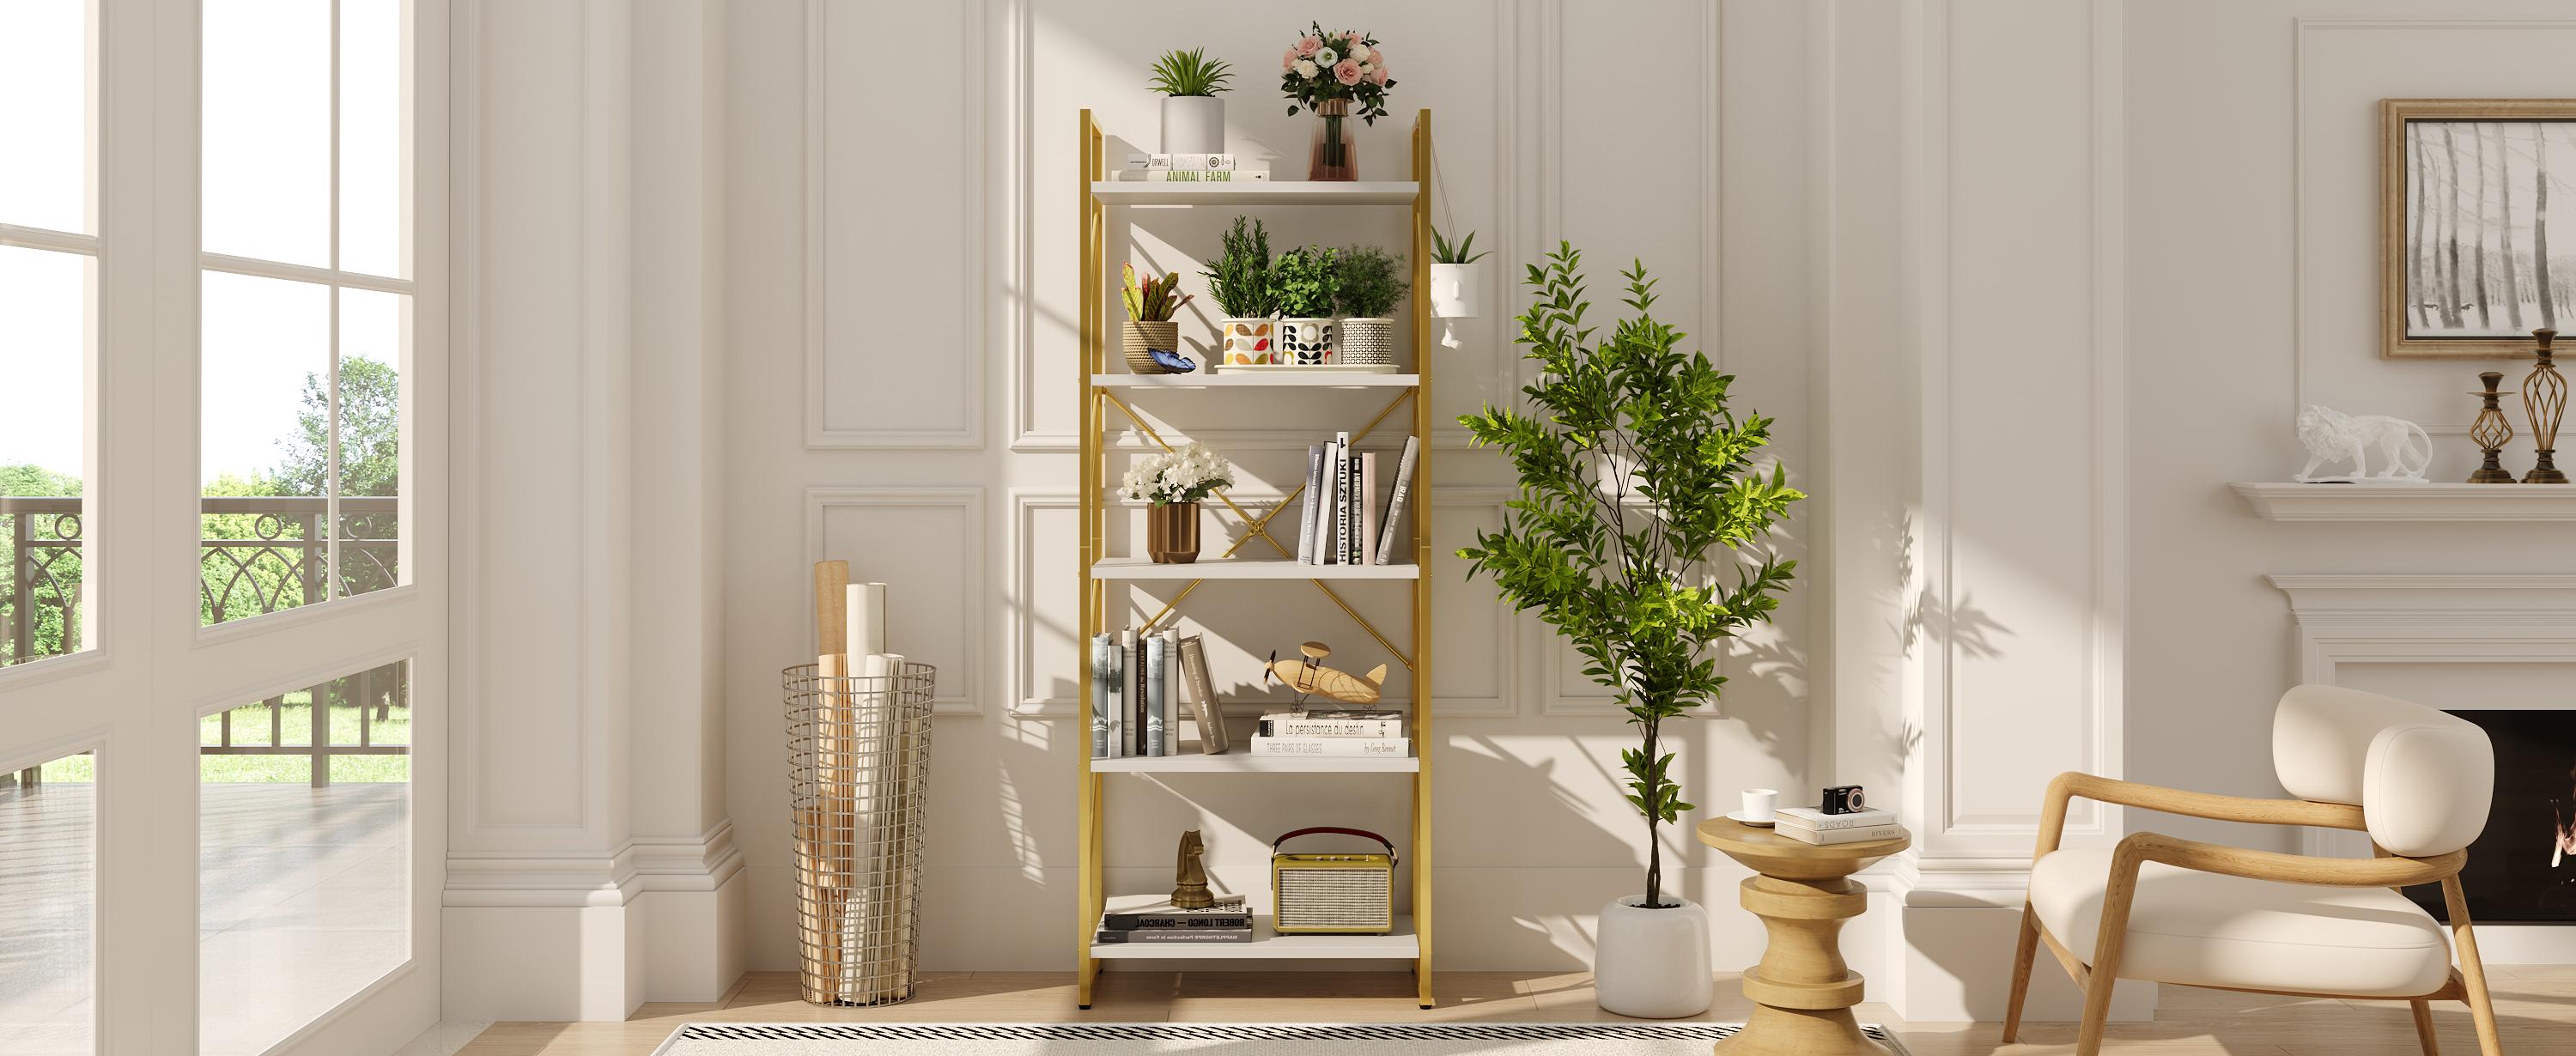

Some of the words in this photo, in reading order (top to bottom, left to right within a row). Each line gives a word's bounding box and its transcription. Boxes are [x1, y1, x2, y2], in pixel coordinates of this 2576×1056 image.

[1151, 157, 1169, 167] ORWELL
[1166, 171, 1200, 182] ANIMAL
[1206, 171, 1230, 182] FARM
[1285, 719, 1293, 735] La
[1295, 721, 1332, 737] persistance
[1334, 721, 1343, 735] du
[1824, 819, 1854, 828] ROADS
